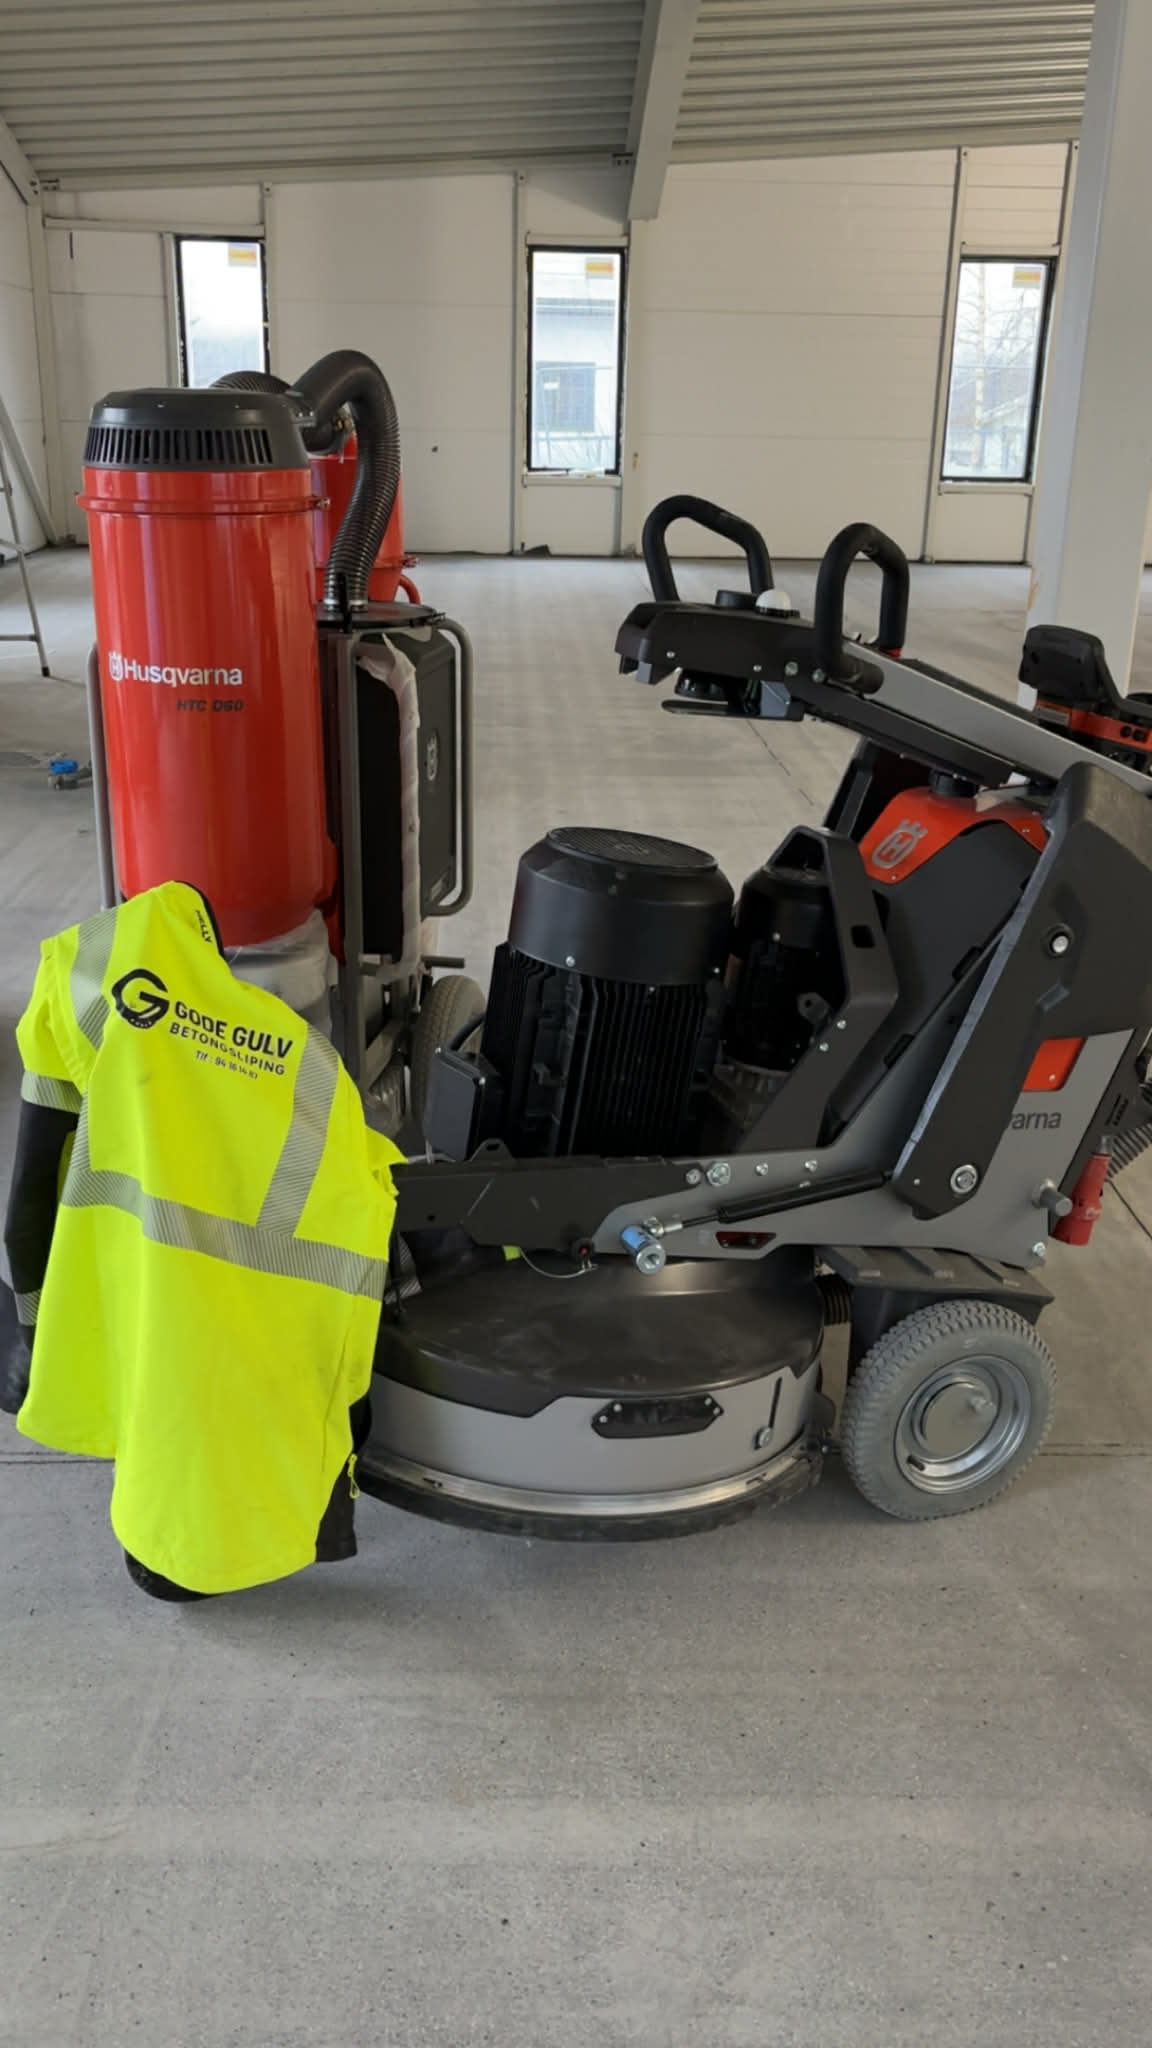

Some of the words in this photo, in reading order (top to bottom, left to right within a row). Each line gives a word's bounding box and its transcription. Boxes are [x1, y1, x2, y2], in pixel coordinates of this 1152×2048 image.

[124, 657, 243, 688] Husqvarna
[176, 698, 208, 712] HTC
[174, 1000, 228, 1041] GODE
[231, 1025, 294, 1060] GULV
[169, 1021, 286, 1076] BETONGSLIPING
[1011, 1111, 1062, 1130] arna
